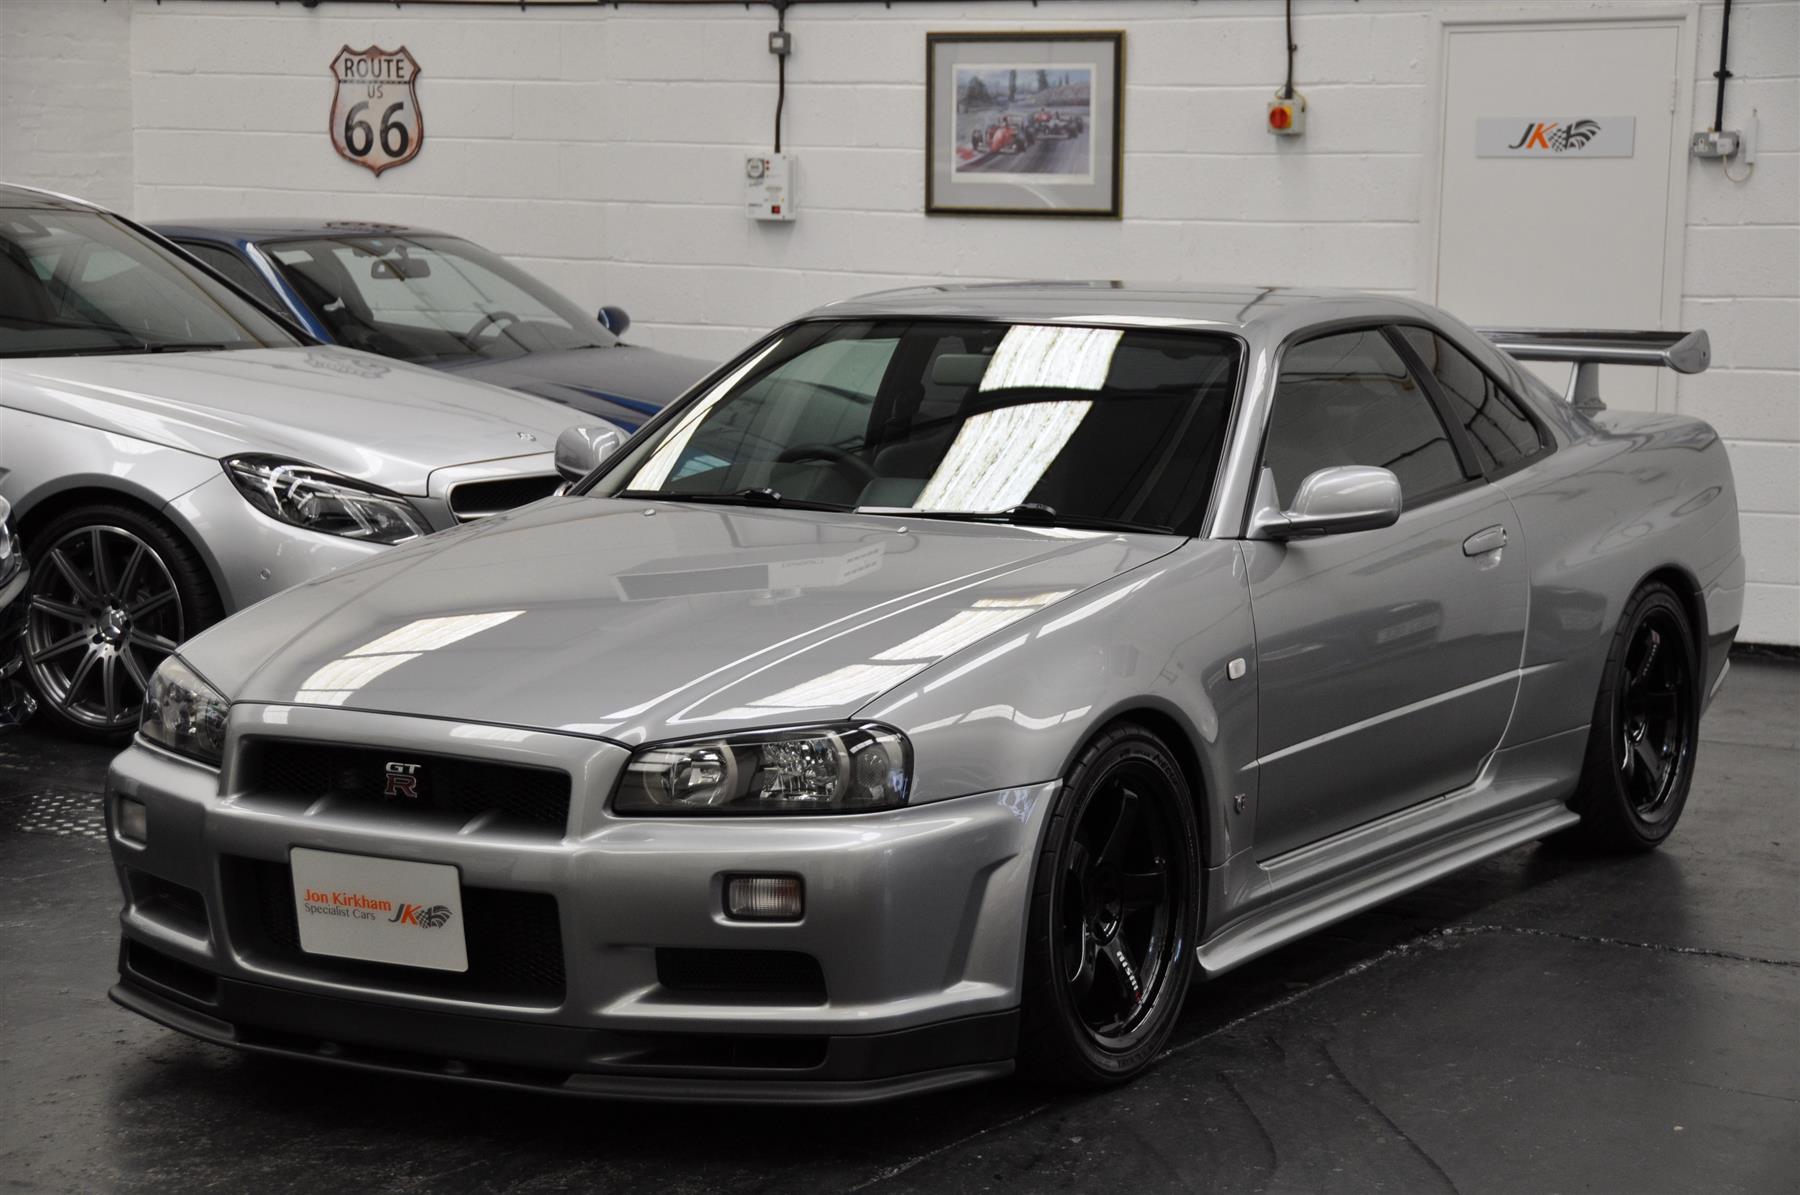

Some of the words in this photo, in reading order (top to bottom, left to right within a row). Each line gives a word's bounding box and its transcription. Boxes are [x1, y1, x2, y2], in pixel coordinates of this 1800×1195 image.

[344, 58, 405, 79] ROUTE
[367, 84, 384, 99] US
[344, 100, 409, 158] 66
[385, 761, 422, 774] GT
[384, 773, 418, 798] R
[304, 888, 328, 904] Jon
[332, 892, 392, 911] Kirkham
[304, 902, 350, 918] Specialist
[352, 908, 376, 920] Cars
[388, 903, 422, 926] JK
